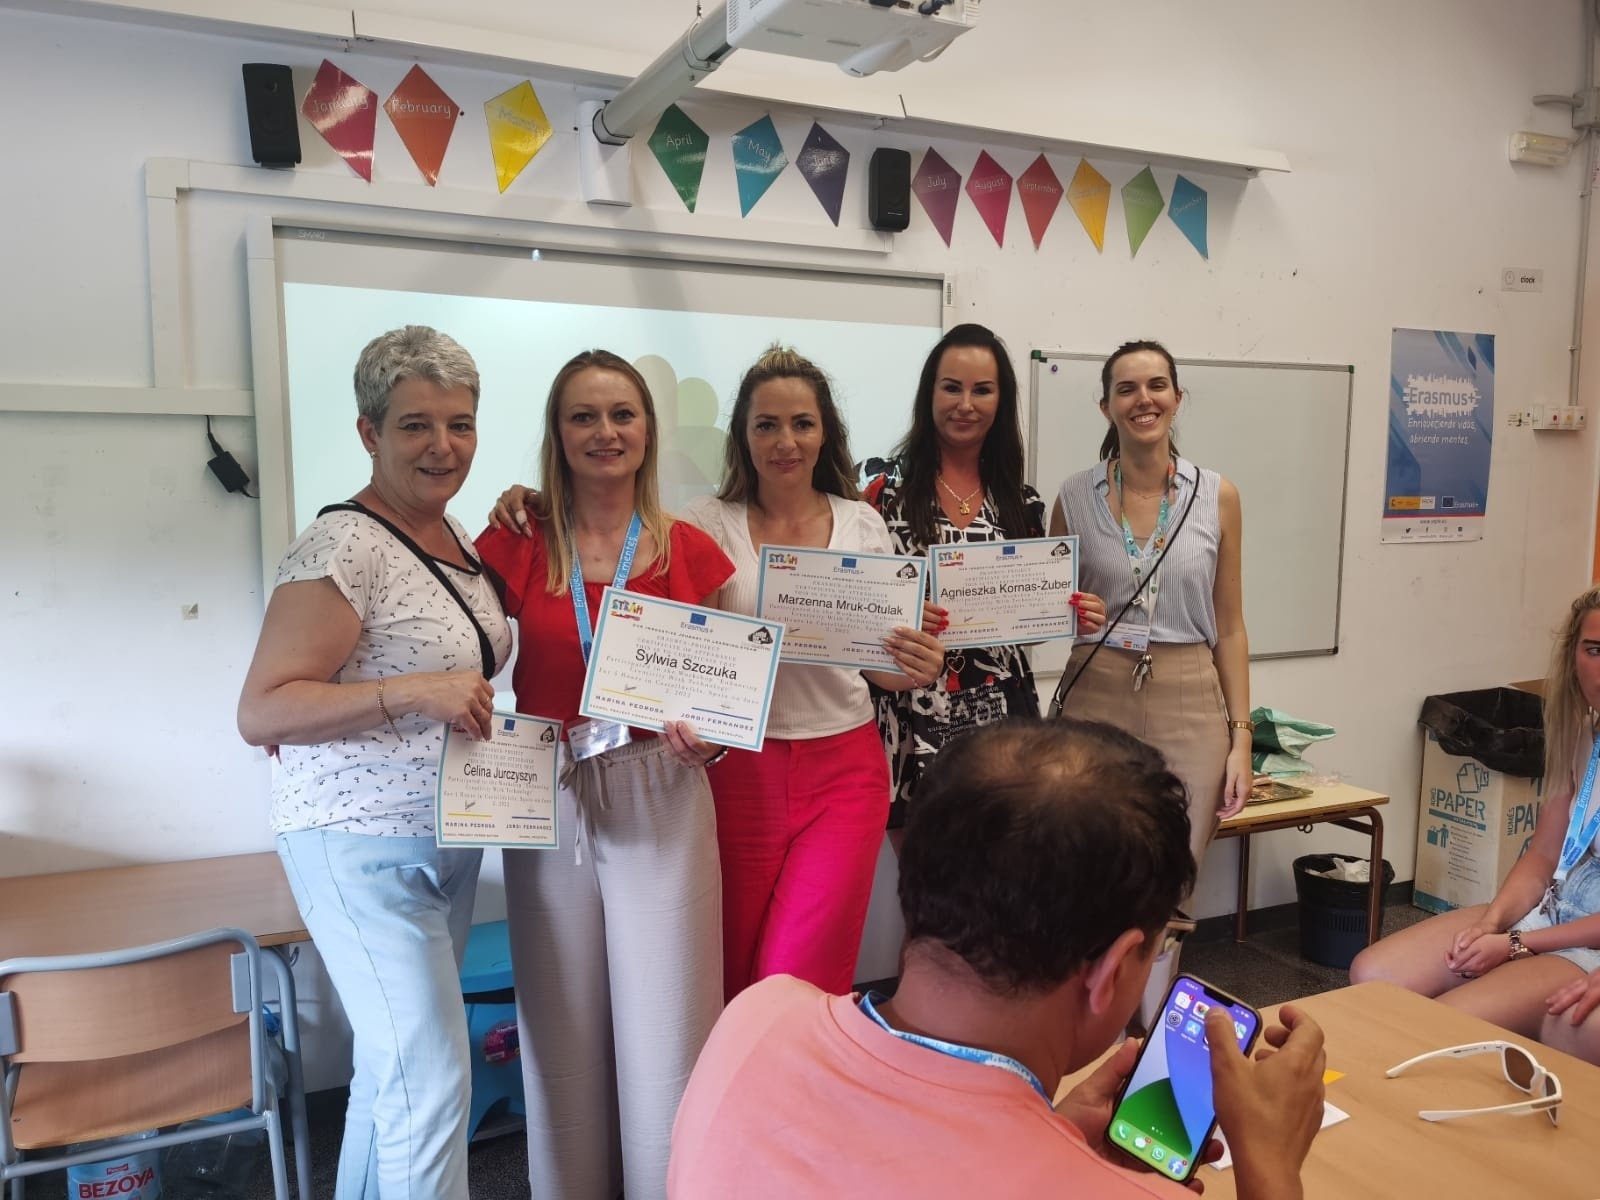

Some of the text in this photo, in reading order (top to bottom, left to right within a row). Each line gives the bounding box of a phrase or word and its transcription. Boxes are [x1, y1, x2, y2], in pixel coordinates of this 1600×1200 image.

[391, 99, 450, 119] February
[666, 133, 693, 150] April
[748, 139, 772, 162] May
[812, 153, 836, 168] June
[927, 175, 948, 190] July
[974, 176, 1006, 193] August
[1021, 178, 1058, 195] September
[1409, 387, 1475, 406] Erasmus+
[940, 584, 996, 599] Agnieszka
[611, 597, 644, 615] STEAM
[778, 593, 903, 616] Marzenna Mruk-Otulak
[634, 647, 738, 680] Sylwia Szczuka
[595, 695, 664, 713] MARINA PEDROSA
[679, 712, 753, 731] JORDI FERNANDEZ
[463, 763, 491, 777] Celina
[493, 767, 537, 785] Jurczyszyn
[1436, 788, 1486, 821] PAPER
[79, 1167, 155, 1199] BEZOYA
